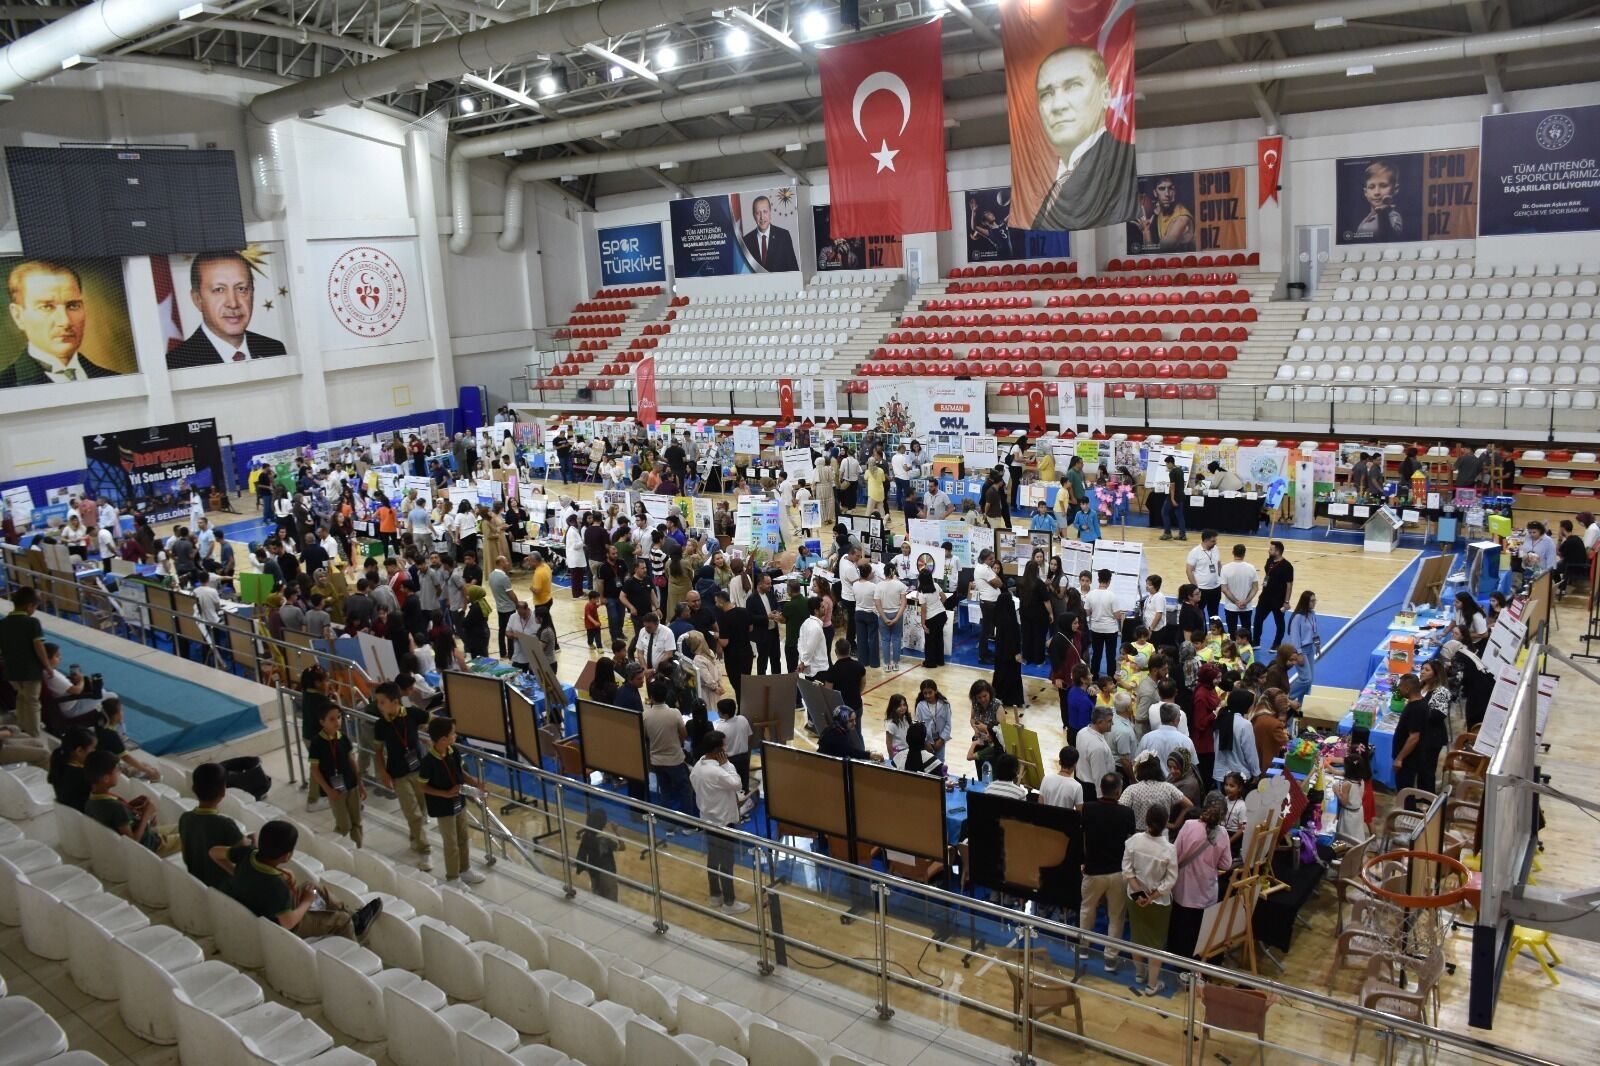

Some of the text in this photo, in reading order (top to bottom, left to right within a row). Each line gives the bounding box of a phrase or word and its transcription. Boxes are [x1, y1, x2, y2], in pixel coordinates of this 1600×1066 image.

[1429, 154, 1465, 178] SPOR
[1512, 159, 1595, 174] TÜM ANTRENÖR
[1199, 171, 1231, 195] SPOR
[1500, 168, 1600, 184] VE SPORCULARIMIZ
[1504, 184, 1551, 194] BAŞARILAR
[999, 229, 1008, 239] 3
[1200, 224, 1221, 250] BİZ
[602, 237, 640, 255] SPOR
[603, 254, 662, 275] TÜRKİYE
[940, 404, 964, 412] BATMAN
[940, 416, 968, 430] OKUL
[128, 463, 197, 485] Yıl Sonu Sergisi
